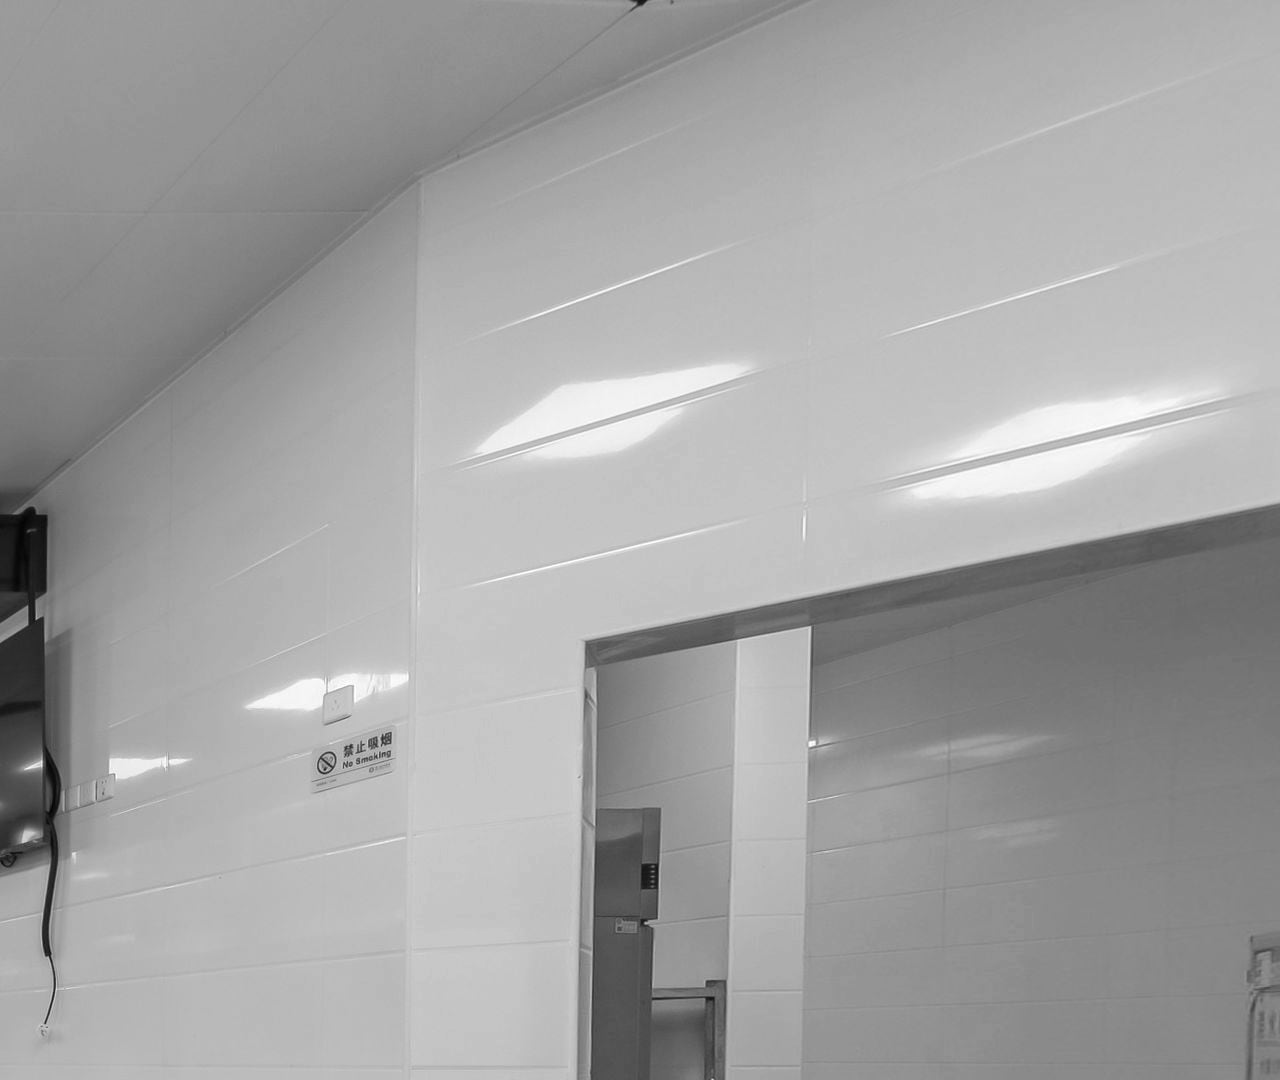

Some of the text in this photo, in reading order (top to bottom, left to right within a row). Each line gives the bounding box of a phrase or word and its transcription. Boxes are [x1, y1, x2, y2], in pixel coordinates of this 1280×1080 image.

[343, 732, 393, 758] 禁止吸烟
[342, 750, 392, 769] No Smoking
